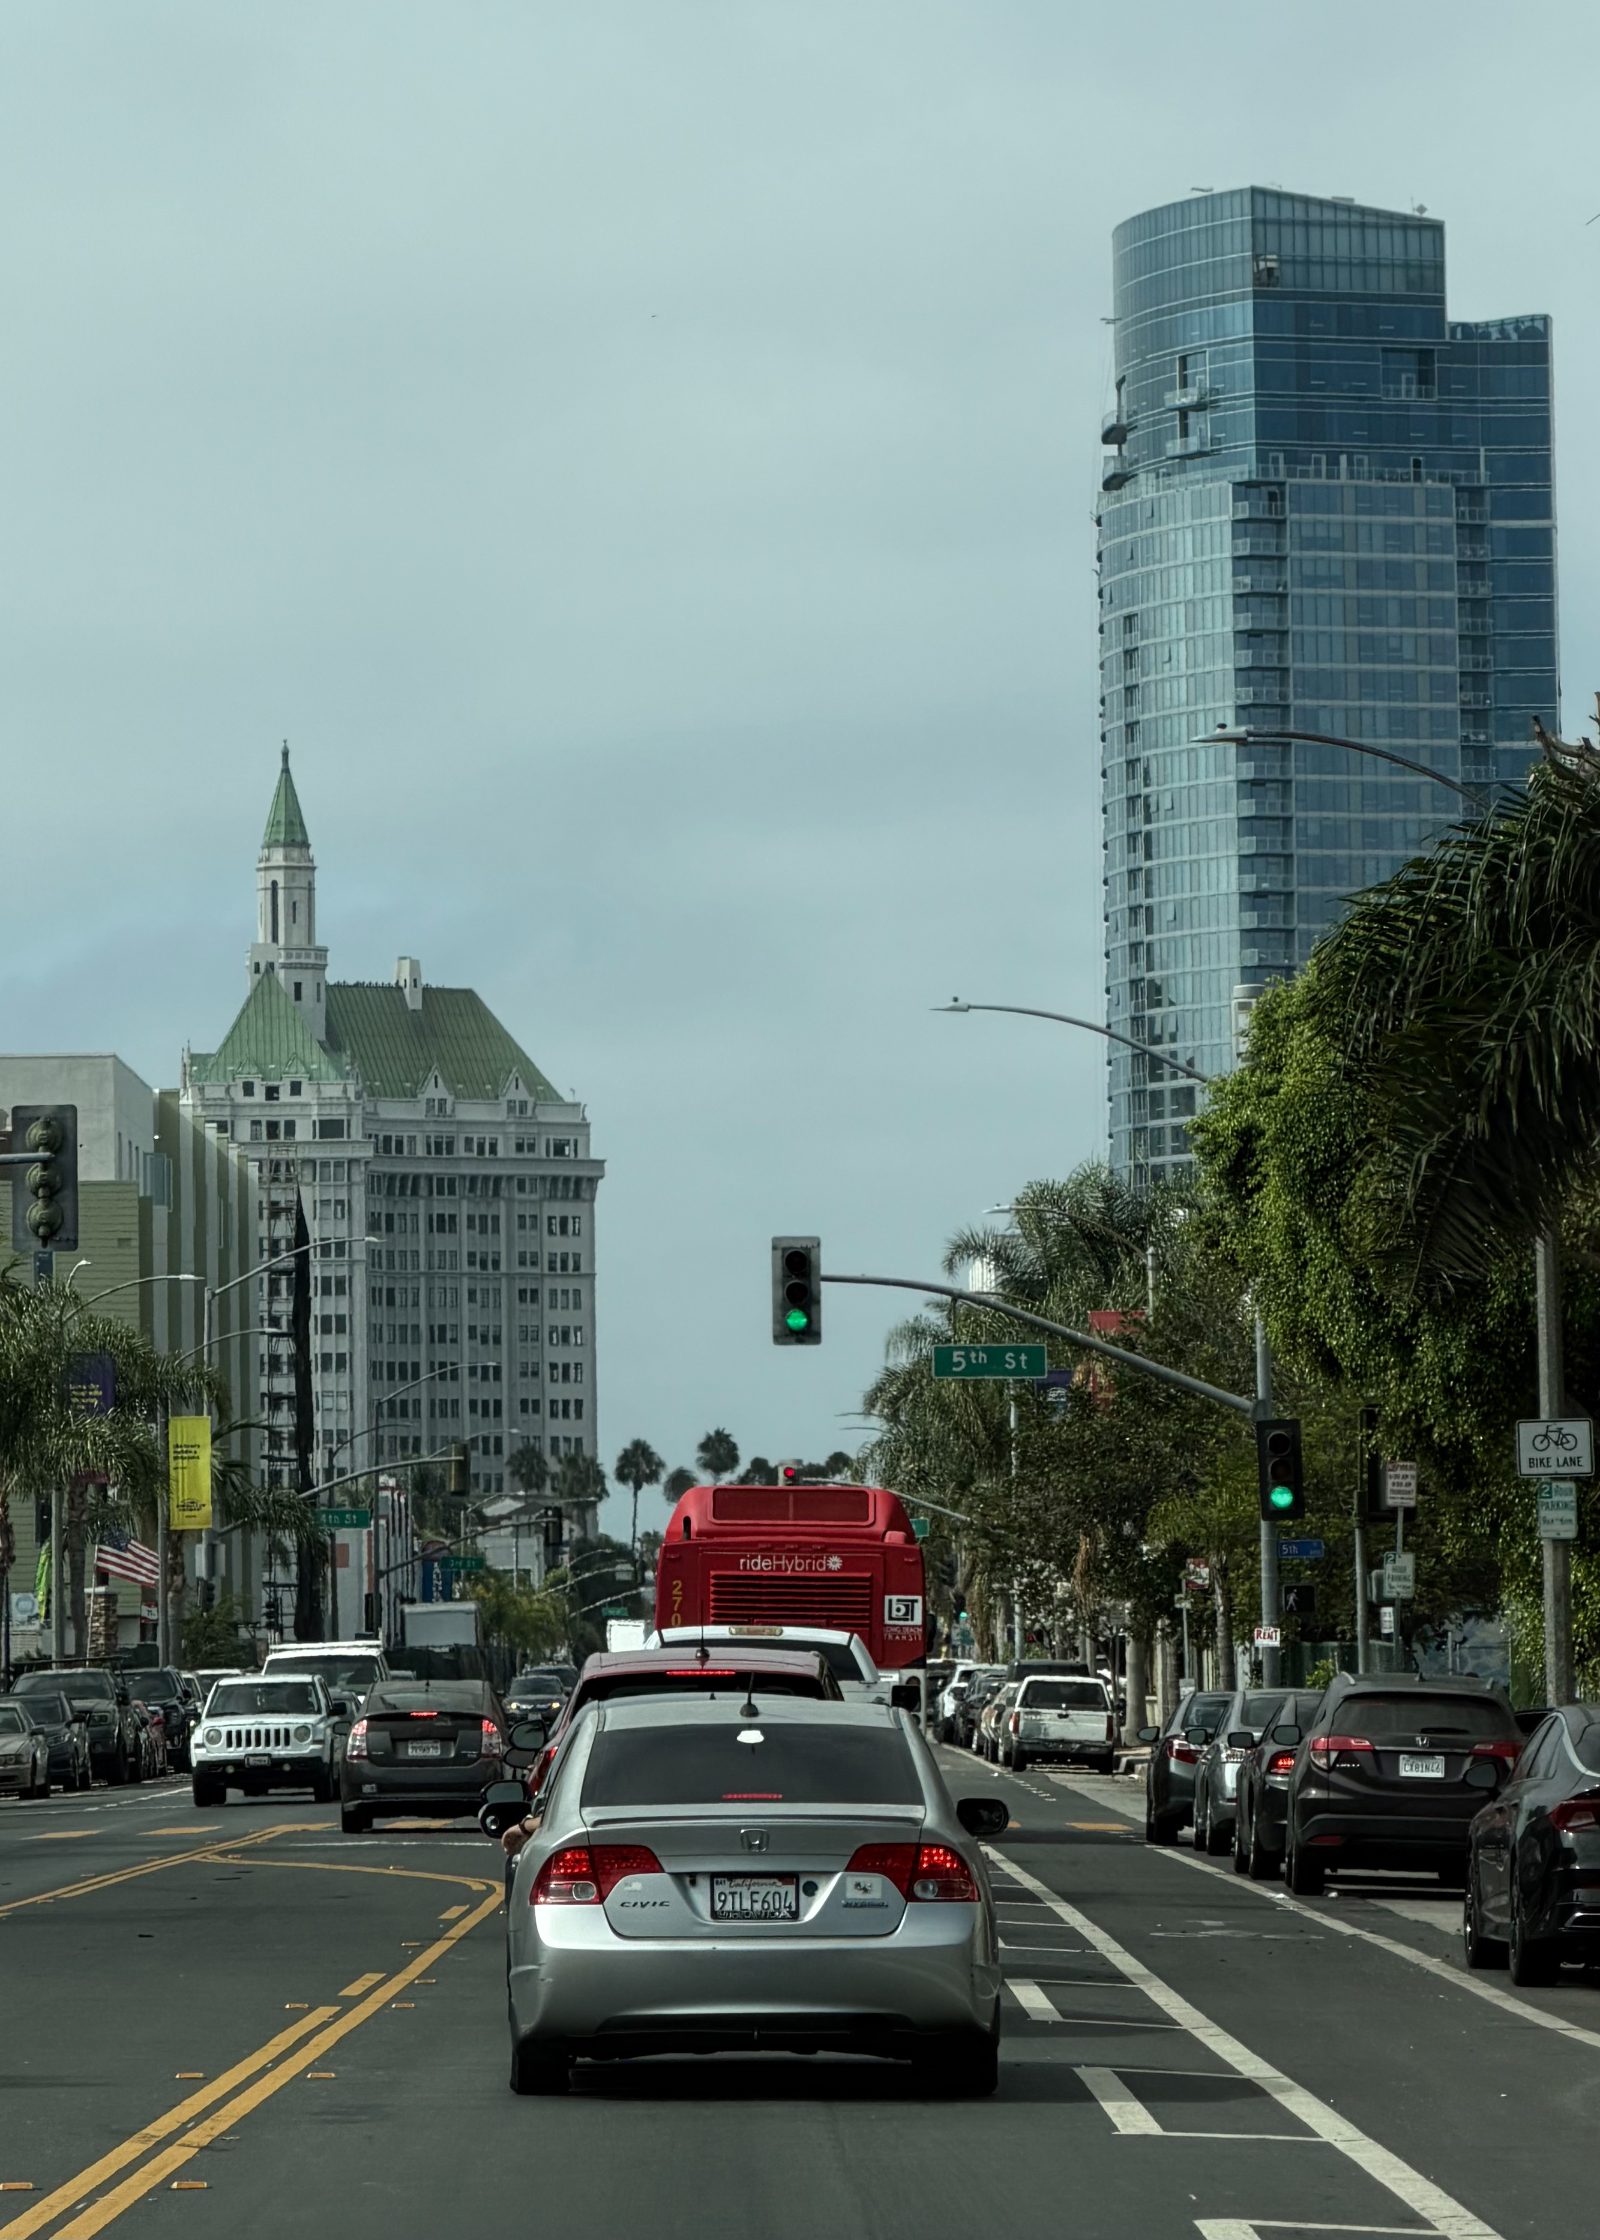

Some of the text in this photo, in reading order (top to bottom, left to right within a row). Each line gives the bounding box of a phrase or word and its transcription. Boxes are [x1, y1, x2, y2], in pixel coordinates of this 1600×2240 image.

[952, 1350, 1028, 1372] 5th St
[1528, 1456, 1583, 1468] BIKE LANE
[1541, 1484, 1550, 1497] 2
[344, 1513, 357, 1524] St
[1282, 1544, 1299, 1555] 5th
[739, 1554, 827, 1574] rideHybrid
[1387, 1554, 1395, 1562] 2
[671, 1580, 683, 1626] 270
[883, 1633, 922, 1641] TRANSIT
[1256, 1629, 1278, 1642] RENT
[619, 1900, 670, 1909] CIVIC
[717, 1890, 792, 1911] 9TLF604
